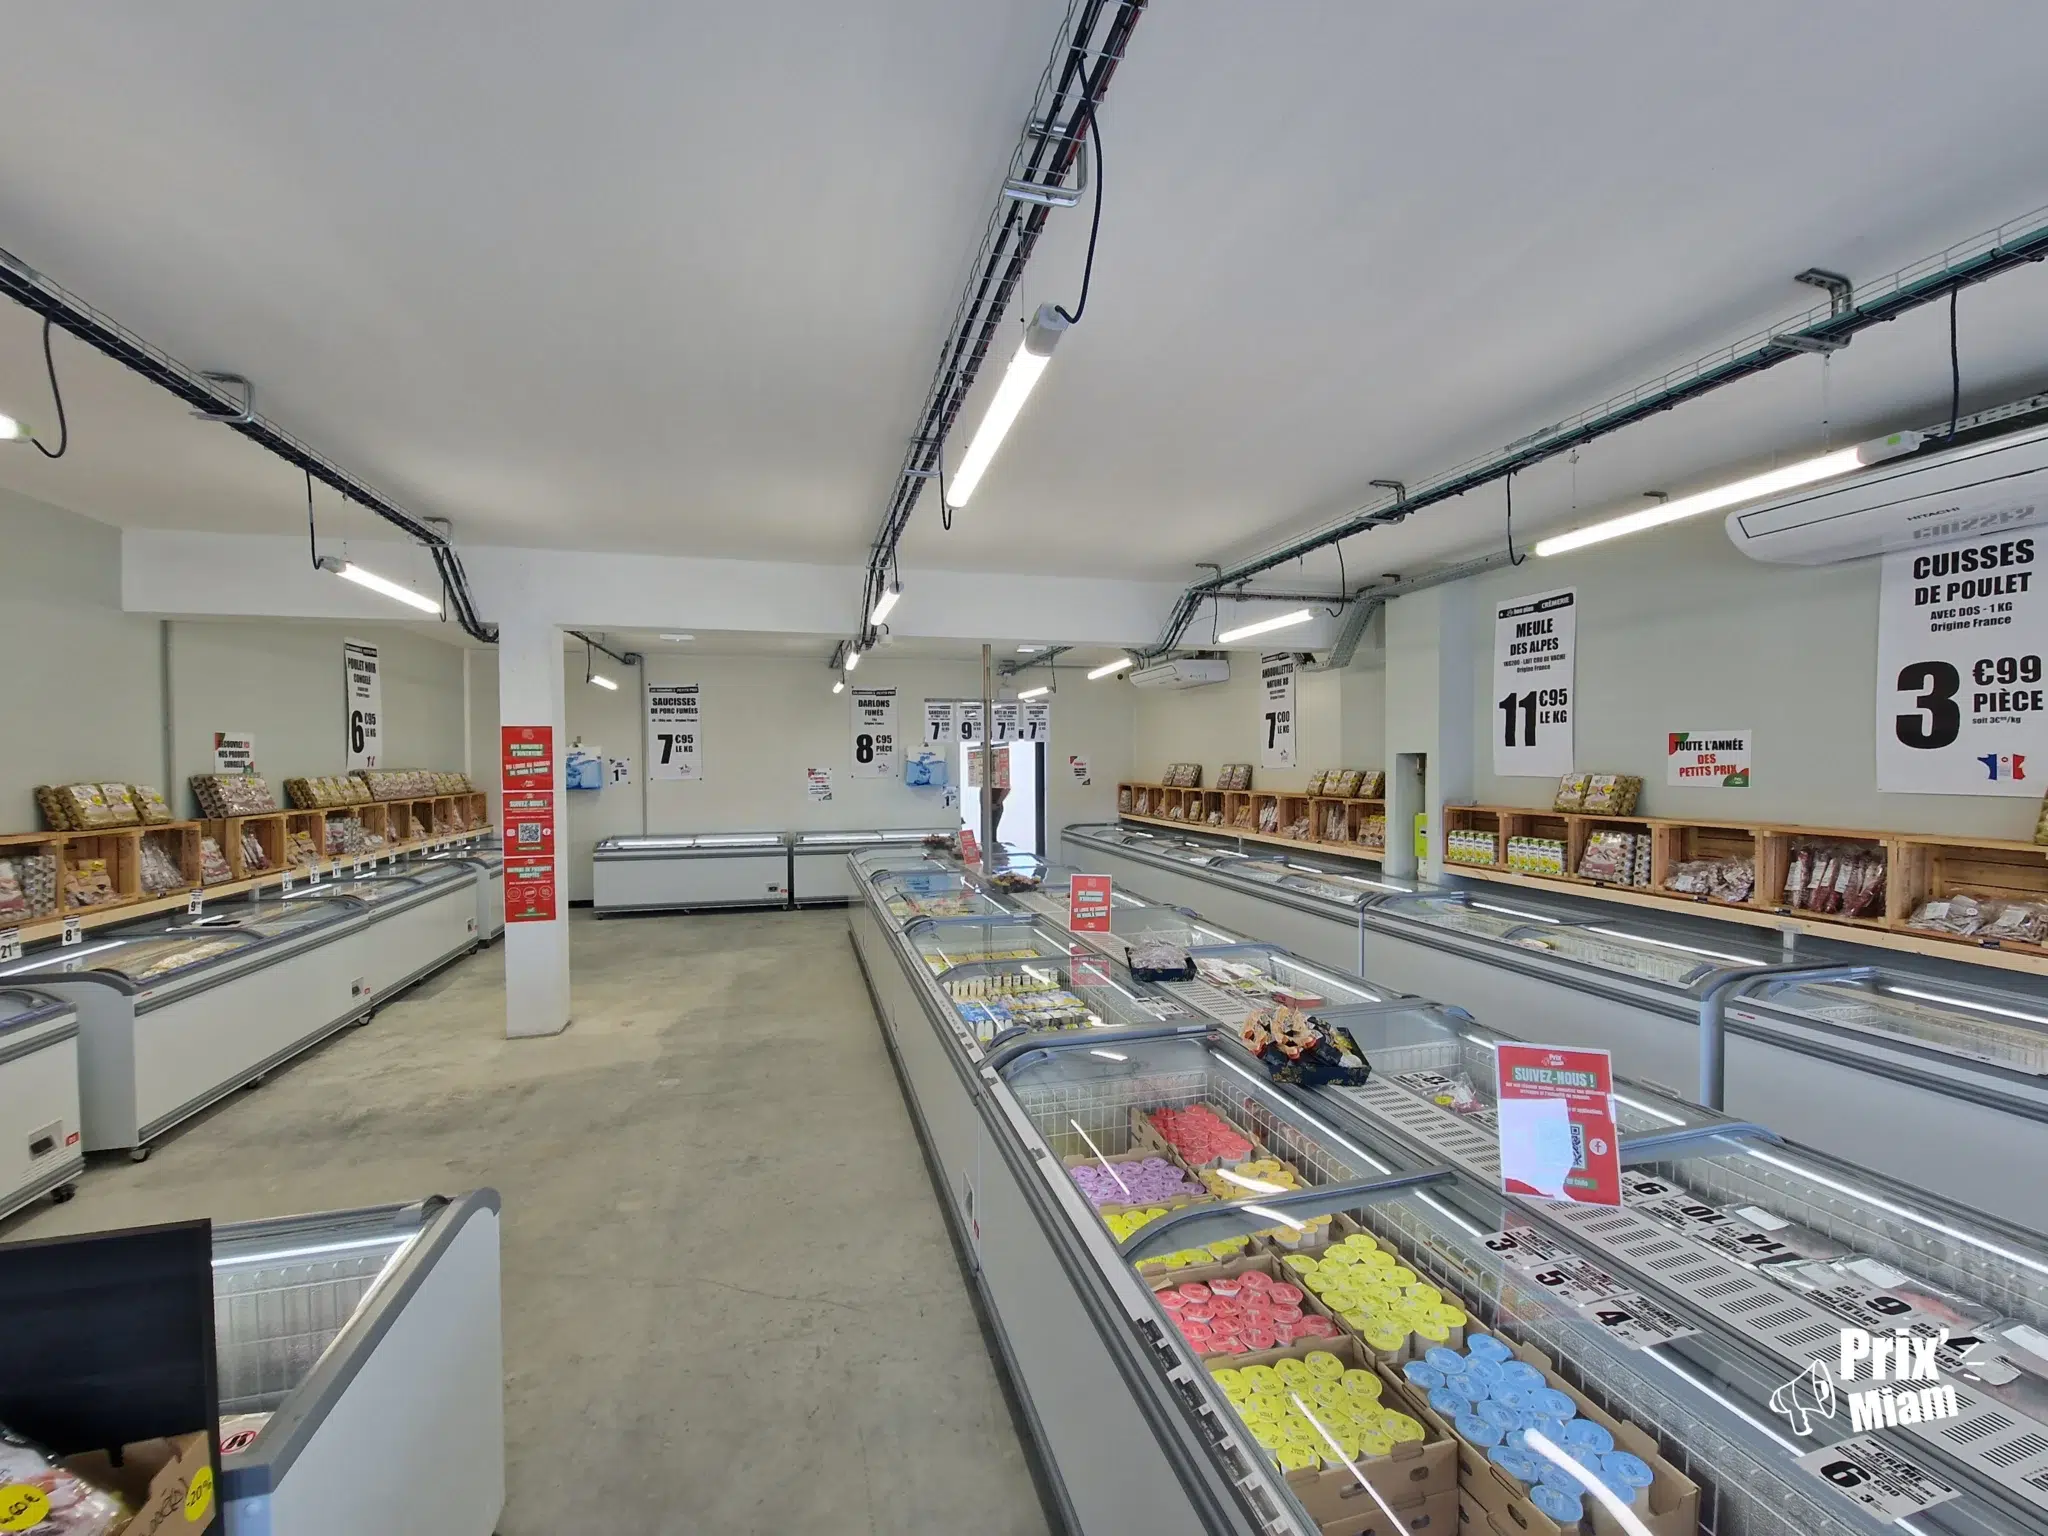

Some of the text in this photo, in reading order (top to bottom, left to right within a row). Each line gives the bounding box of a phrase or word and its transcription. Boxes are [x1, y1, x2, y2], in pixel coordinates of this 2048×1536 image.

[1906, 507, 1960, 521] HITACHI
[1913, 539, 2034, 579] CUISSES
[1915, 572, 2032, 606] DE POULET
[1930, 609, 1956, 620] AVEC
[1959, 605, 1981, 617] DOS
[1990, 604, 1995, 613] 1
[1998, 601, 2013, 612] KG
[1516, 618, 1553, 638] MEULE
[1931, 615, 2011, 632] Origine France
[1510, 637, 1559, 656] DES ALPES
[652, 697, 697, 706] SAUCISSES
[1895, 654, 2042, 750] 3 €99
[1973, 688, 2044, 713] PIÈCE
[864, 708, 884, 716] FUMÉS
[1499, 688, 1568, 747] 11 €95
[1540, 709, 1567, 724] LE KG
[1972, 717, 1987, 725] soit
[351, 710, 364, 754] 6
[931, 721, 940, 740] 7
[961, 721, 973, 740] 9
[997, 721, 1006, 740] 7
[1028, 721, 1037, 740] 7
[1265, 711, 1276, 750] 7
[657, 733, 674, 765] 7
[675, 745, 693, 753] LE KG
[856, 733, 874, 764] 8
[1675, 737, 1744, 751] TOUTE L'ANNÉE
[1697, 753, 1717, 765] DES
[1679, 764, 1737, 777] PETITS PRIX
[190, 900, 196, 912] 9
[65, 929, 73, 942] 8
[0, 944, 12, 959] 21
[1514, 1067, 1587, 1087] SUIVEZ-NOUS
[1633, 1182, 1669, 1195] 9
[1651, 1206, 1688, 1227] TRAVERS
[1681, 1206, 1727, 1225] 10
[1485, 1237, 1519, 1252] 3
[1711, 1237, 1743, 1254] PLUMA
[1736, 1233, 1787, 1254] 14
[1535, 1269, 1573, 1287] 5
[1810, 1289, 1846, 1305] PORC
[1865, 1296, 1912, 1316] 6
[1595, 1311, 1634, 1327] 4
[1636, 1300, 1683, 1328] FROMAGE
[1855, 1309, 1881, 1325] CÔTE
[1944, 1336, 1986, 1354] 7
[1875, 1452, 1925, 1484] CRÈME
[1820, 1460, 1872, 1489] 6
[1873, 1479, 1901, 1498] €00
[1859, 1494, 1875, 1504] 3
